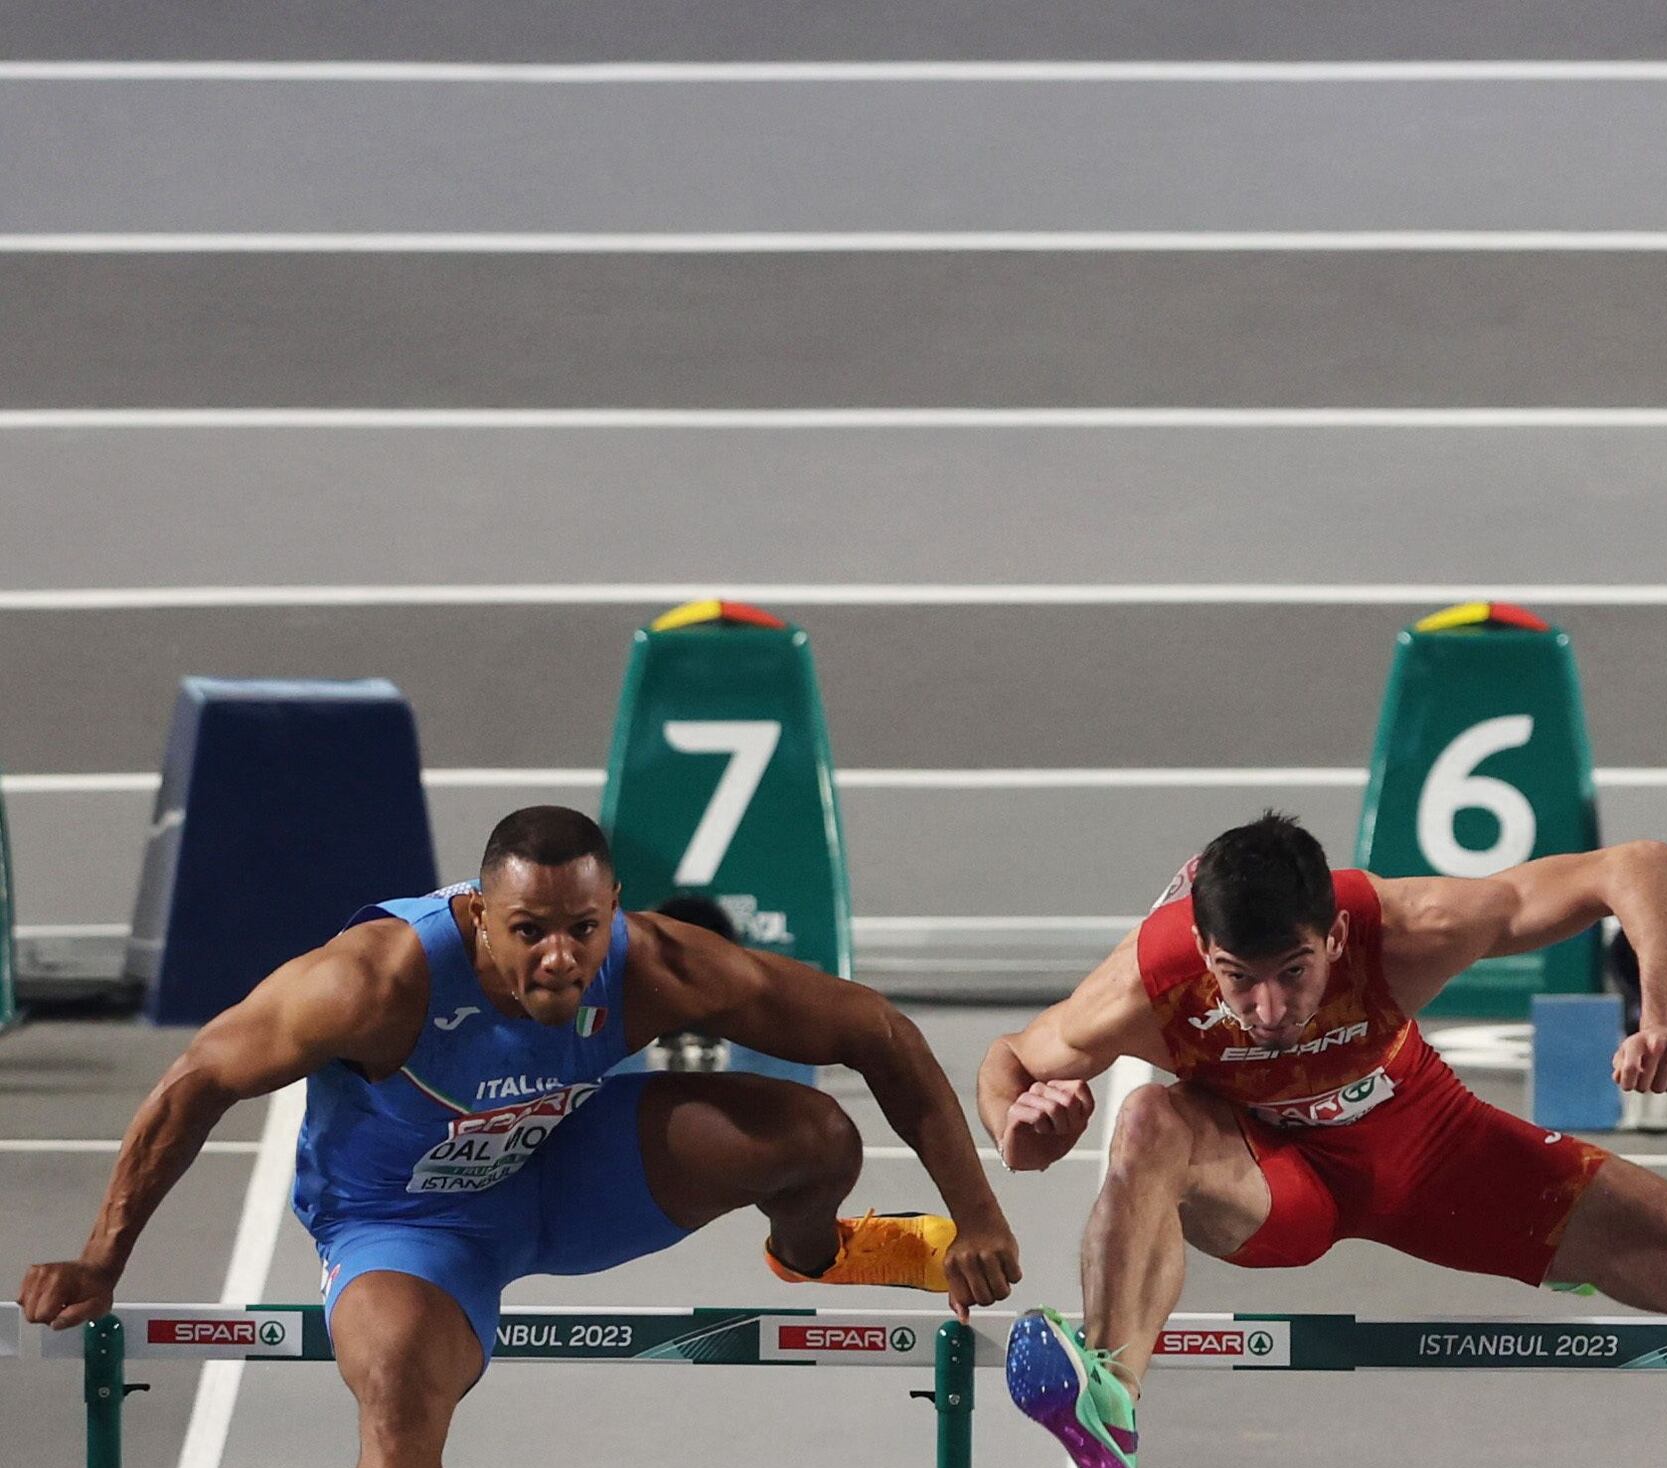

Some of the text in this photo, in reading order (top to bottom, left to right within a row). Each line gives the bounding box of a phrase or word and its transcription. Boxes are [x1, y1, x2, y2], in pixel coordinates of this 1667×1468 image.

[662, 720, 782, 887] 7
[1416, 713, 1537, 879] 6
[429, 1139, 491, 1162] DAL
[174, 1323, 254, 1342] SPAR
[496, 1325, 633, 1347] NBUL 2023
[805, 1329, 885, 1349] SPAR
[1162, 1334, 1242, 1352] SPAR
[1418, 1333, 1619, 1357] ISTANBUL 2023
